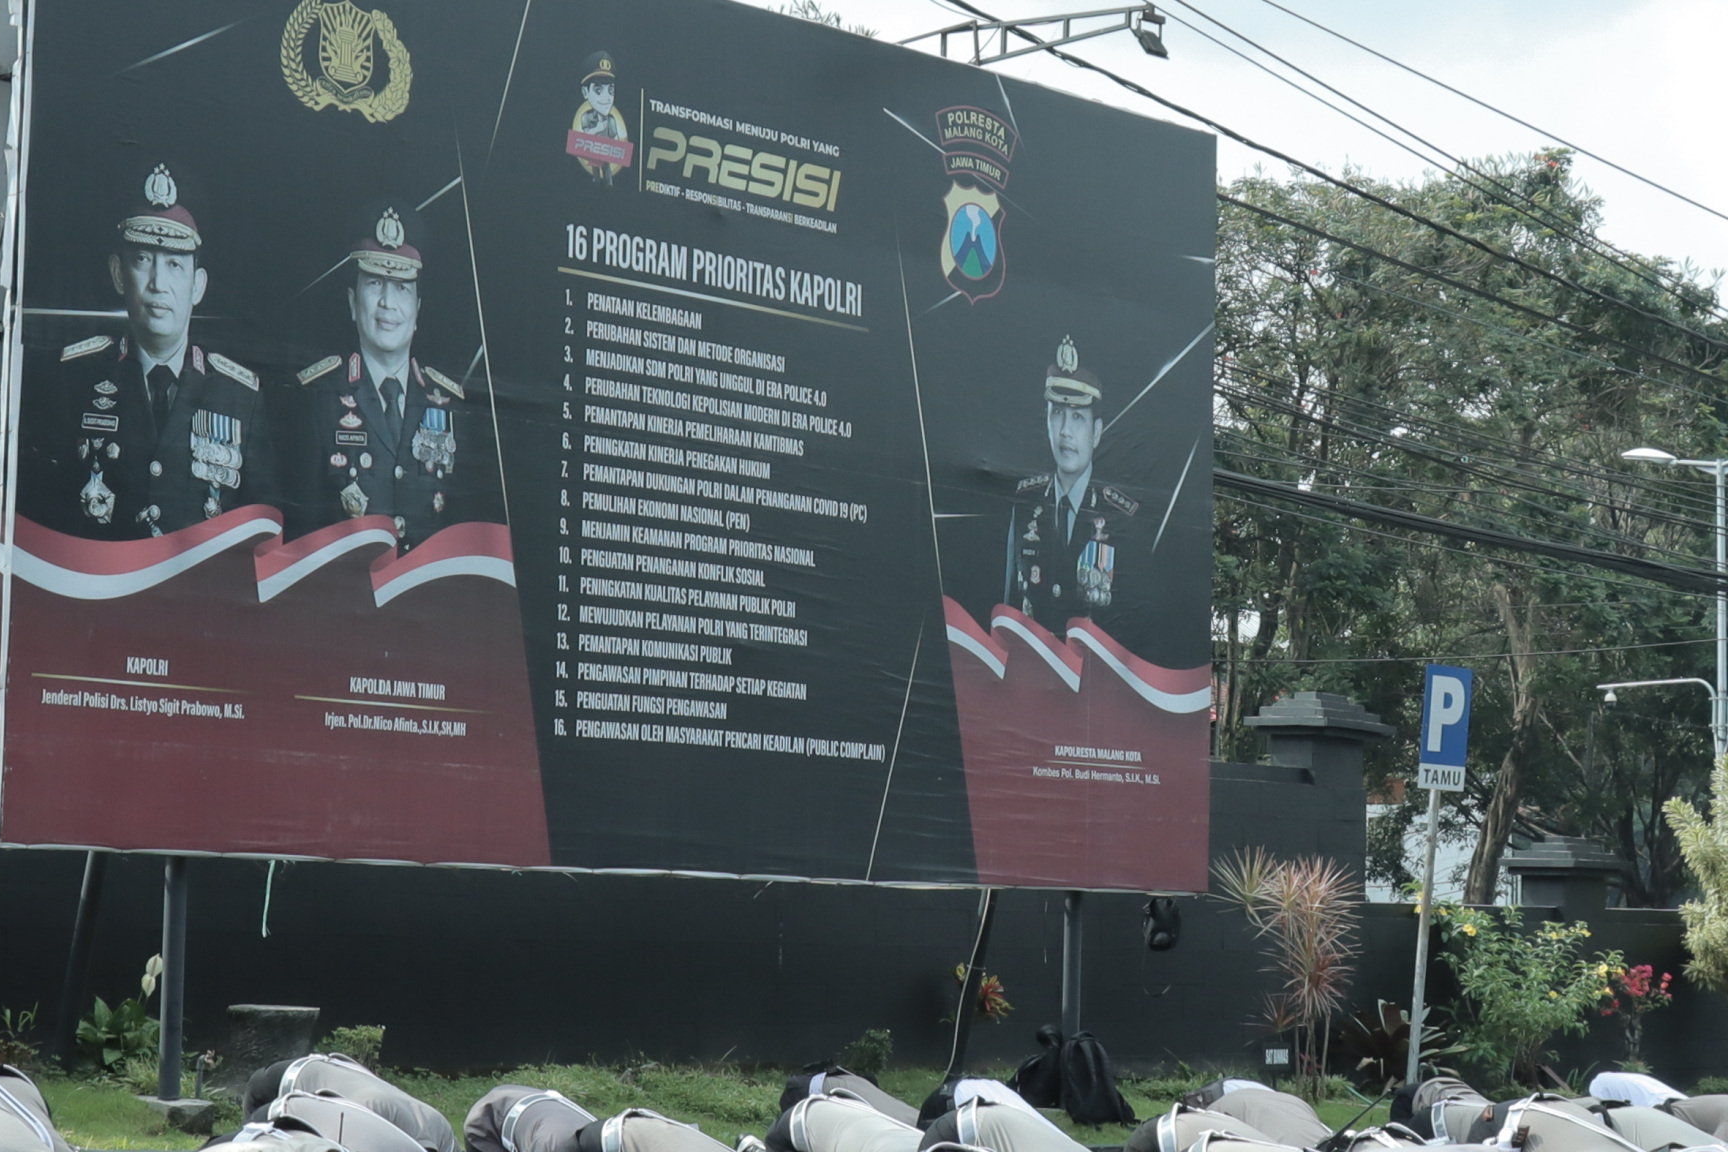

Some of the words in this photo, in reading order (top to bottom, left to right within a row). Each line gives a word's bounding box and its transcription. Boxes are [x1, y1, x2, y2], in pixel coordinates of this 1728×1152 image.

[650, 100, 732, 131] TRANSFORMASI
[736, 120, 778, 142] MENUJU
[780, 131, 810, 150] POLRI
[812, 138, 839, 157] YANG
[944, 126, 982, 139] MALANG
[985, 132, 1008, 155] KOTA
[948, 111, 1005, 140] POLRESTA
[575, 138, 625, 159] PRESISI
[951, 157, 974, 168] JAWA
[975, 159, 1001, 180] TIMUR
[647, 127, 841, 212] PRESISI
[566, 224, 588, 260] 16
[592, 229, 686, 282] PROGRAM
[692, 250, 785, 301] PRIORITAS
[790, 270, 861, 316] KAPOLRI
[565, 289, 572, 307] 1.
[587, 292, 634, 318] PENATAAN
[636, 301, 701, 330] KELEMBAGAAN
[565, 318, 574, 334] 2.
[586, 321, 641, 348] PERUBAHAN
[643, 331, 675, 354] SISTEM
[677, 337, 696, 357] DAN
[697, 340, 732, 363] METODE
[734, 347, 784, 372] ORGANISASI
[564, 347, 573, 362] 3.
[586, 349, 644, 376] MENJADIKAN
[645, 359, 666, 380] SDM
[667, 363, 693, 384] POLRI
[695, 368, 717, 388] YANG
[719, 372, 753, 394] UNGGUL
[755, 379, 764, 396] DI
[766, 381, 782, 399] ERA
[784, 384, 812, 404] POLICE
[813, 389, 826, 407] 4.0
[563, 374, 572, 391] 4.
[585, 377, 640, 403] PERUBAHAN
[642, 386, 690, 412] TEKNOLOGI
[692, 395, 742, 420] KEPOLISIAN
[744, 404, 779, 426] MODERN
[781, 410, 790, 428] DI
[792, 412, 807, 431] ERA
[809, 415, 837, 436] POLICE
[838, 420, 851, 438] 4.0
[562, 403, 572, 419] 5.
[584, 405, 645, 432] PEMANTAPAN
[647, 415, 683, 437] KINERJA
[685, 421, 751, 448] PEMELIHARAAN
[753, 432, 803, 456] KAMTIBMAS
[563, 434, 571, 450] 6.
[584, 435, 646, 461] PENINGKATAN
[648, 444, 684, 467] KINERJA
[686, 450, 737, 474] PENEGAKAN
[738, 458, 770, 479] HUKUM
[561, 461, 568, 478] 7.
[583, 463, 644, 489] PEMANTAPAN
[646, 472, 695, 497] DUKUNGAN
[696, 479, 722, 501] POLRI
[724, 483, 754, 506] DALAM
[755, 488, 812, 515] PENANGANAN
[813, 496, 838, 519] COVID
[839, 500, 848, 520] 19
[849, 502, 866, 523] (PC)
[561, 489, 570, 507] 8.
[582, 491, 635, 516] PEMULIHAN
[637, 499, 678, 522] EKONOMI
[680, 504, 723, 528] NASIONAL
[725, 510, 749, 532] (PEN)
[560, 518, 569, 535] 9.
[582, 520, 630, 544] MENJAMIN
[632, 526, 682, 550] KEAMANAN
[684, 533, 726, 556] PROGRAM
[728, 539, 772, 561] PRIORITAS
[774, 544, 815, 567] NASIONAL
[559, 546, 571, 564] 10.
[581, 548, 633, 572] PENGUATAN
[636, 555, 696, 579] PENANGANAN
[698, 563, 734, 584] KONFLIK
[735, 567, 765, 587] SOSIAL
[558, 575, 569, 592] 11.
[580, 577, 642, 601] PENINGKATAN
[644, 584, 686, 606] KUALITAS
[688, 590, 737, 612] PELAYANAN
[739, 596, 769, 615] PUBLIK
[771, 599, 795, 618] POLRI
[557, 604, 570, 621] 12.
[579, 605, 643, 630] MEWUJUDKAN
[645, 612, 696, 635] PELAYANAN
[698, 618, 723, 638] POLRI
[725, 621, 747, 640] YANG
[750, 624, 807, 646] TERINTEGRASI
[126, 657, 168, 676] KAPOLRI
[557, 632, 569, 650] 13.
[578, 634, 639, 657] PEMANTAPAN
[641, 640, 698, 662] KOMUNIKASI
[700, 645, 731, 665] PUBLIK
[349, 677, 391, 696] KAPOLDA
[392, 681, 416, 698] JAWA
[418, 683, 445, 701] TIMUR
[556, 661, 568, 678] 14.
[578, 663, 640, 686] PENGAWASAN
[642, 669, 687, 690] PIMPINAN
[690, 673, 734, 694] TERHADAP
[736, 677, 765, 697] SETIAP
[767, 680, 806, 700] KEGIATAN
[42, 689, 81, 708] Jenderal
[83, 691, 108, 710] Polisi
[110, 693, 127, 711] Drs.
[130, 694, 157, 713] Listyo
[159, 696, 179, 715] Sigit
[181, 698, 222, 718] Prabowo,
[224, 701, 245, 719] M.Si.
[325, 712, 346, 730] Irjen.
[555, 690, 567, 707] 15.
[576, 692, 630, 713] PENGUATAN
[632, 696, 664, 715] FUNGSI
[666, 698, 726, 719] PENGAWASAN
[1426, 674, 1466, 753] P
[554, 719, 566, 736] 16.
[576, 720, 639, 742] PENGAWASAN
[641, 725, 663, 744] OLEH
[665, 727, 722, 749] MASYARAKAT
[725, 732, 761, 752] PENCARI
[763, 735, 804, 756] KEADILAN
[806, 738, 838, 758] (PUBLIC
[840, 741, 885, 762] COMPLAIN)
[1054, 745, 1096, 759] KAPOLRESTA
[1097, 748, 1124, 761] MALANG
[1125, 750, 1141, 762] KOTA
[1423, 768, 1461, 787] TAMU
